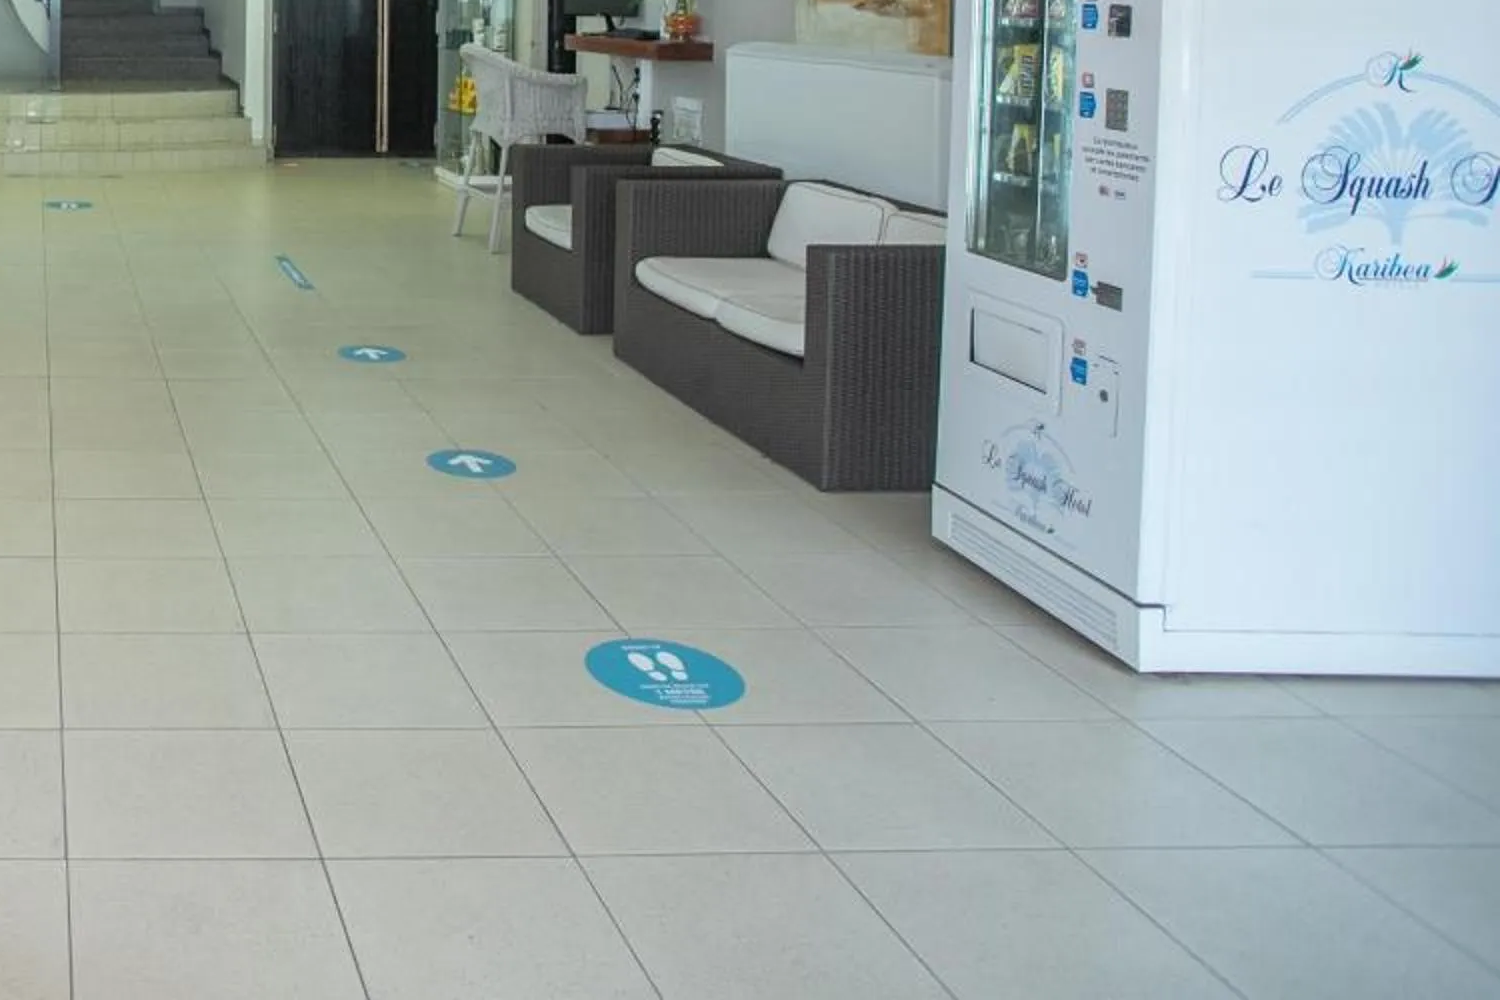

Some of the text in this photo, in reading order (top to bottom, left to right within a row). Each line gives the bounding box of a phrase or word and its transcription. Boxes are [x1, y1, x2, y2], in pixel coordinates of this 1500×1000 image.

[1217, 144, 1283, 203] Le
[1301, 145, 1430, 216] Squash
[1314, 245, 1432, 286] Karibea
